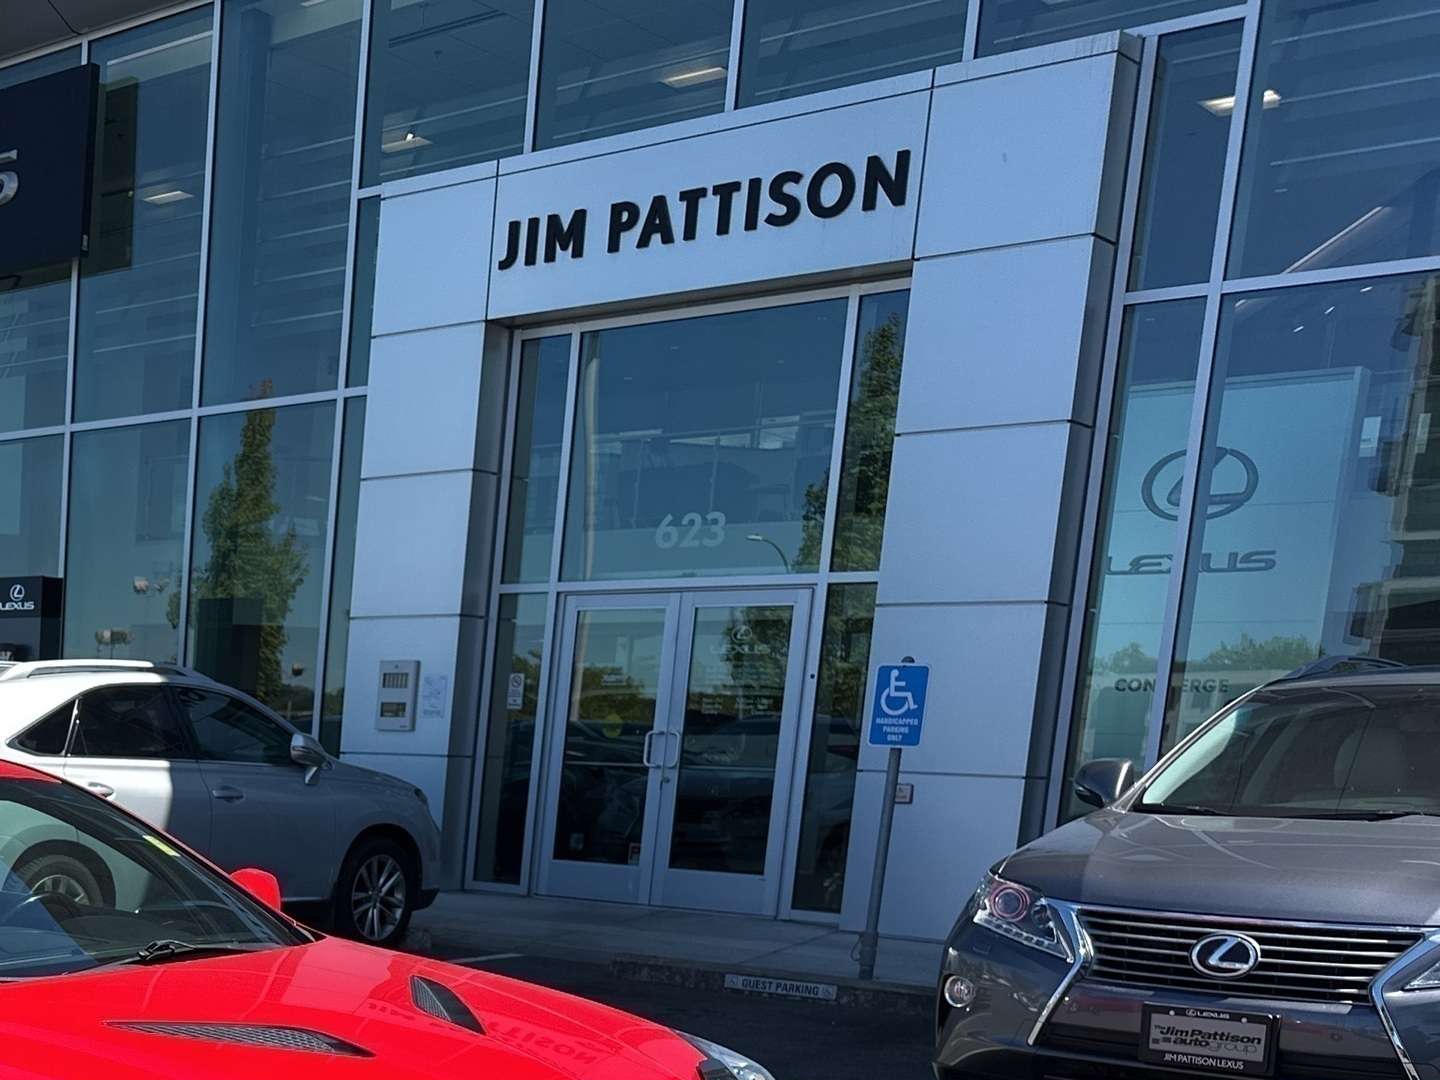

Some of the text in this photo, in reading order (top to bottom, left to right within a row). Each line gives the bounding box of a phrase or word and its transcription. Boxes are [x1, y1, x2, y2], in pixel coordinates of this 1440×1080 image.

[498, 149, 911, 271] JIM PATTISON
[655, 511, 726, 549] 623
[1106, 550, 1277, 576] LEUS
[0, 601, 35, 611] LEXUS
[1115, 677, 1229, 693] CONERGE
[775, 982, 820, 996] PARKING
[1159, 1026, 1189, 1038] Jim
[1189, 1029, 1262, 1045] Pattison
[1177, 1055, 1217, 1067] PATTISON
[1217, 1059, 1244, 1070] LEXUS
